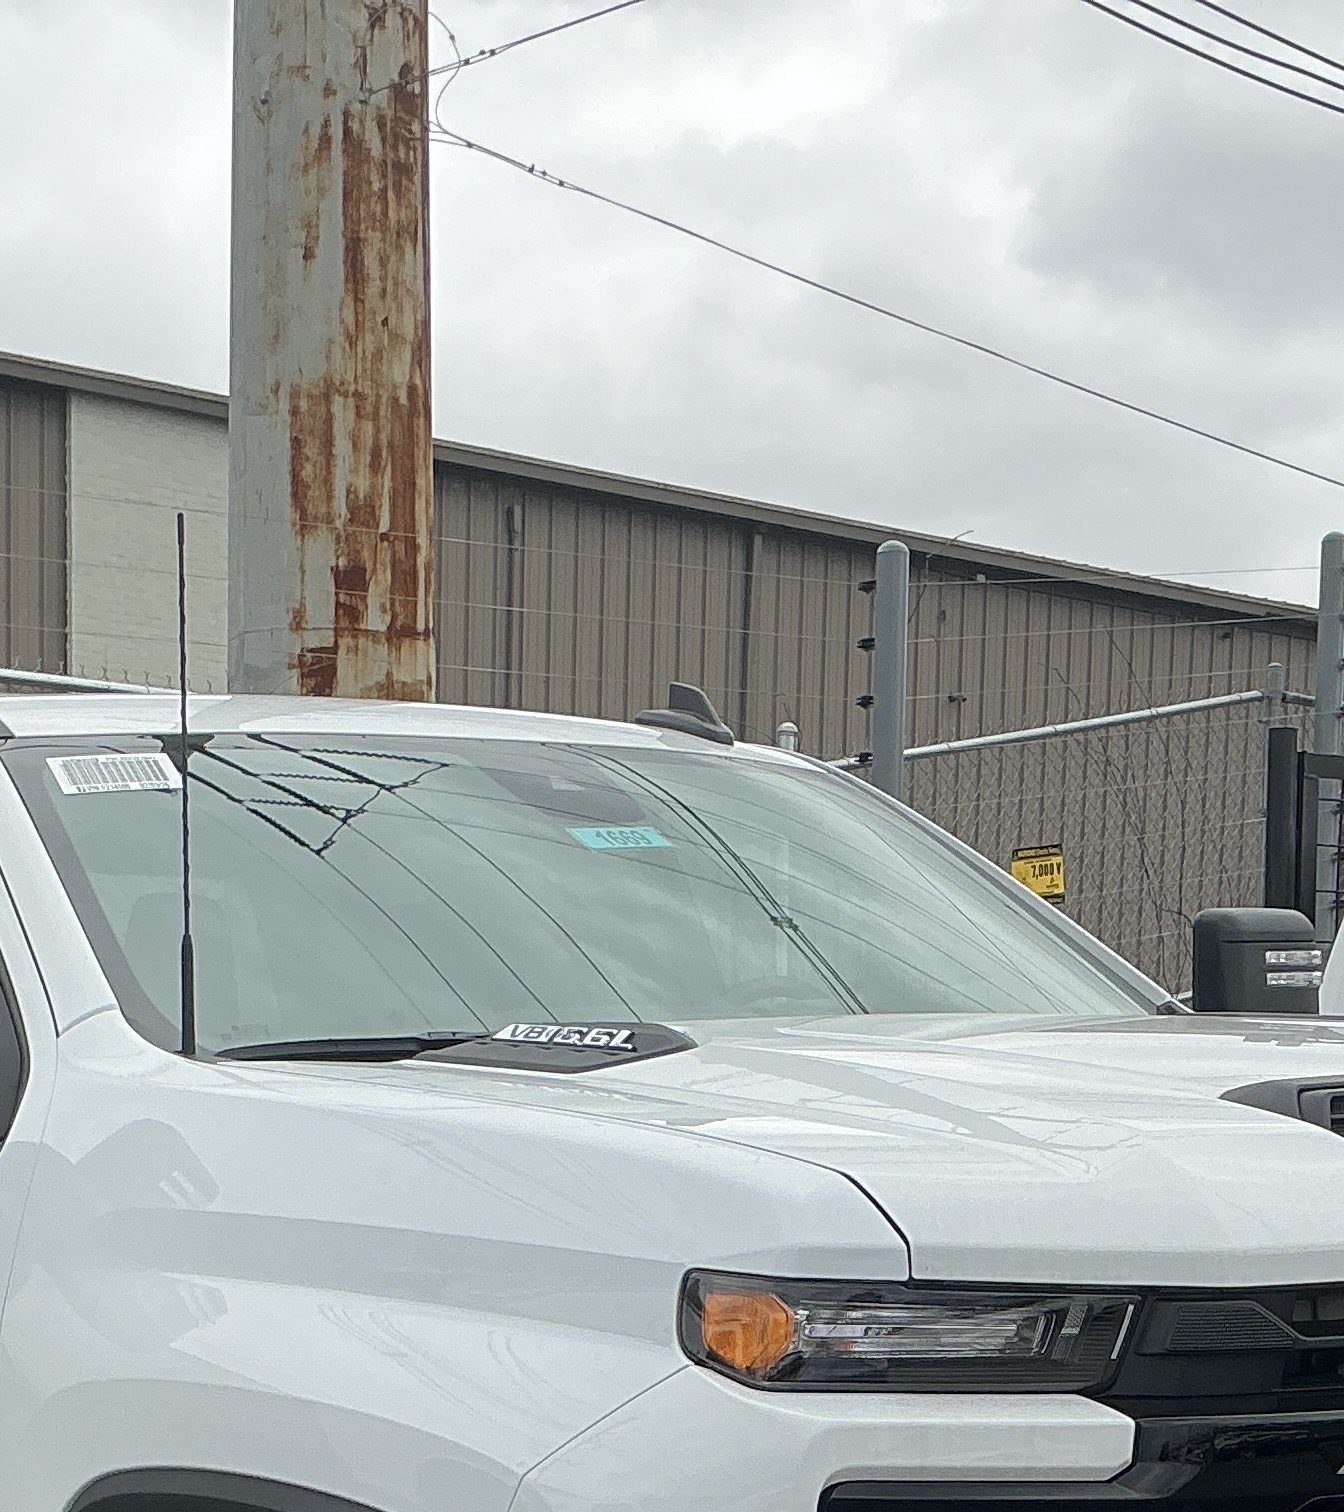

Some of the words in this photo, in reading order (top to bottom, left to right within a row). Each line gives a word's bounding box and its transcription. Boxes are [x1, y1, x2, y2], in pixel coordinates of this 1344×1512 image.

[596, 830, 653, 847] 1669
[1030, 863, 1055, 881] 7,000
[509, 1025, 546, 1040] V8
